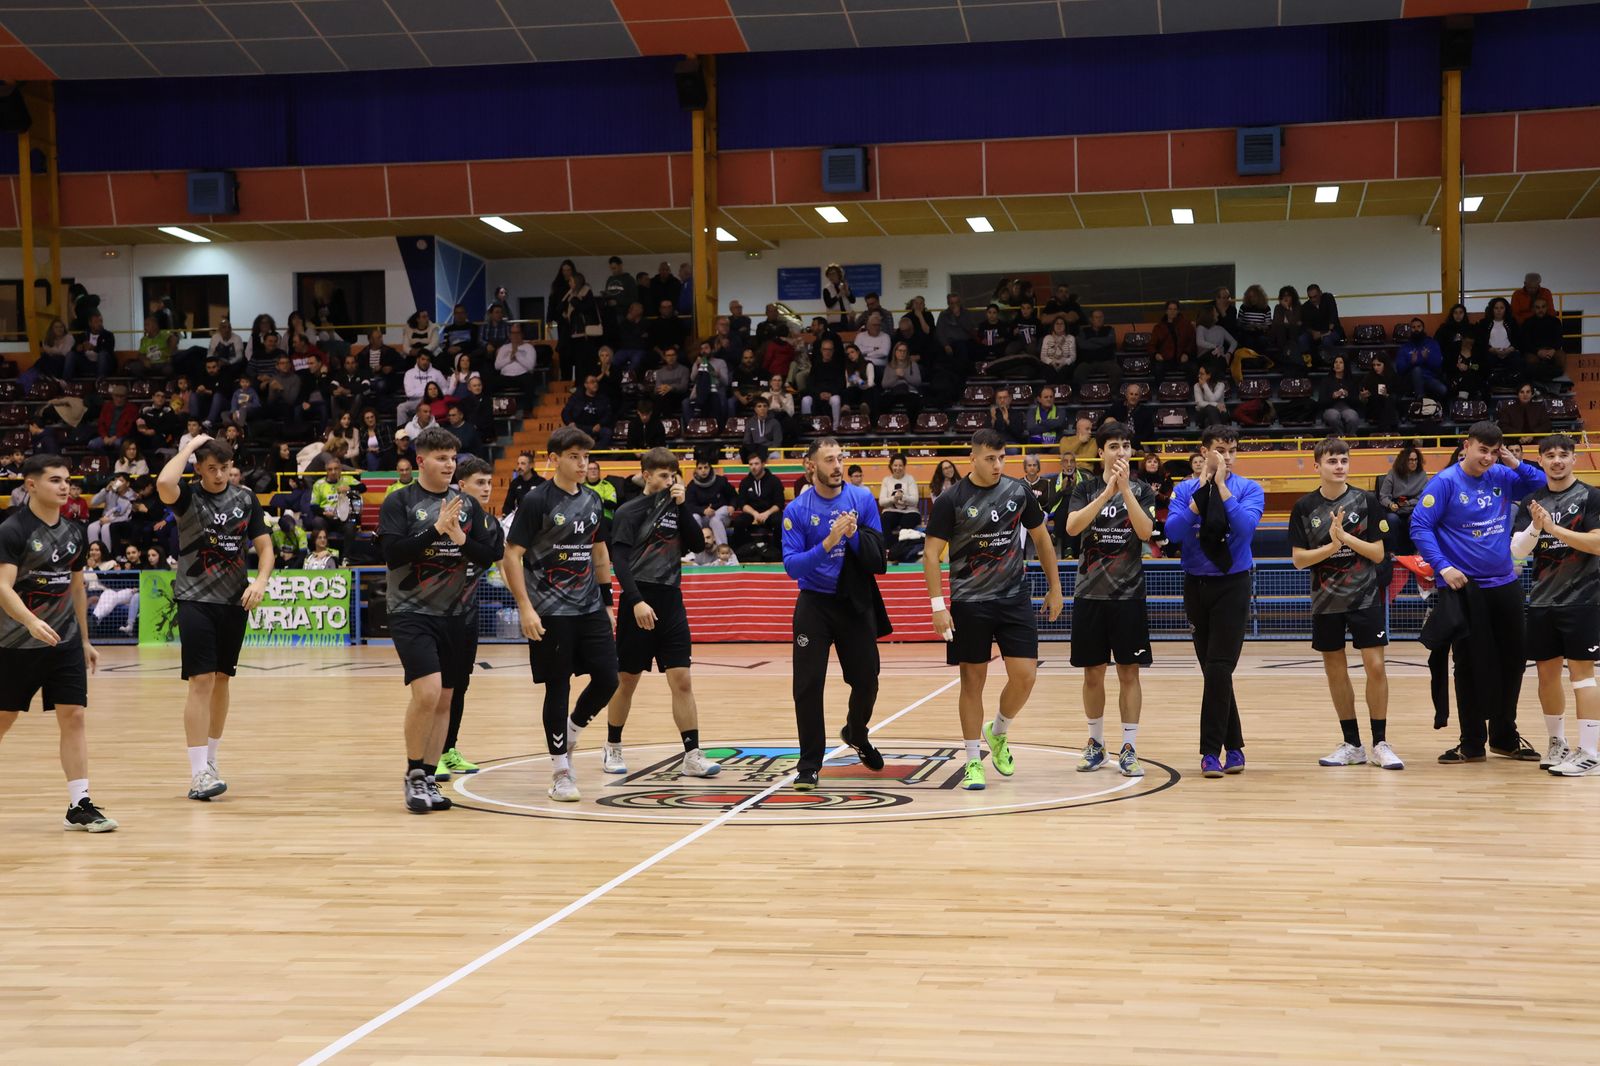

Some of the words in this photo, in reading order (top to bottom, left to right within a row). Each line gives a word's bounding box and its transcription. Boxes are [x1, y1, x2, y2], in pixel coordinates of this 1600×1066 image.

[1477, 496, 1493, 509] 92
[990, 509, 999, 522] 8
[1100, 506, 1117, 518] 40
[213, 513, 228, 526] 59
[573, 520, 585, 534] 14
[979, 540, 989, 548] 50
[51, 548, 60, 562] 6
[424, 548, 435, 557] 50
[558, 552, 568, 561] 50
[247, 606, 347, 631] VIRIATO
